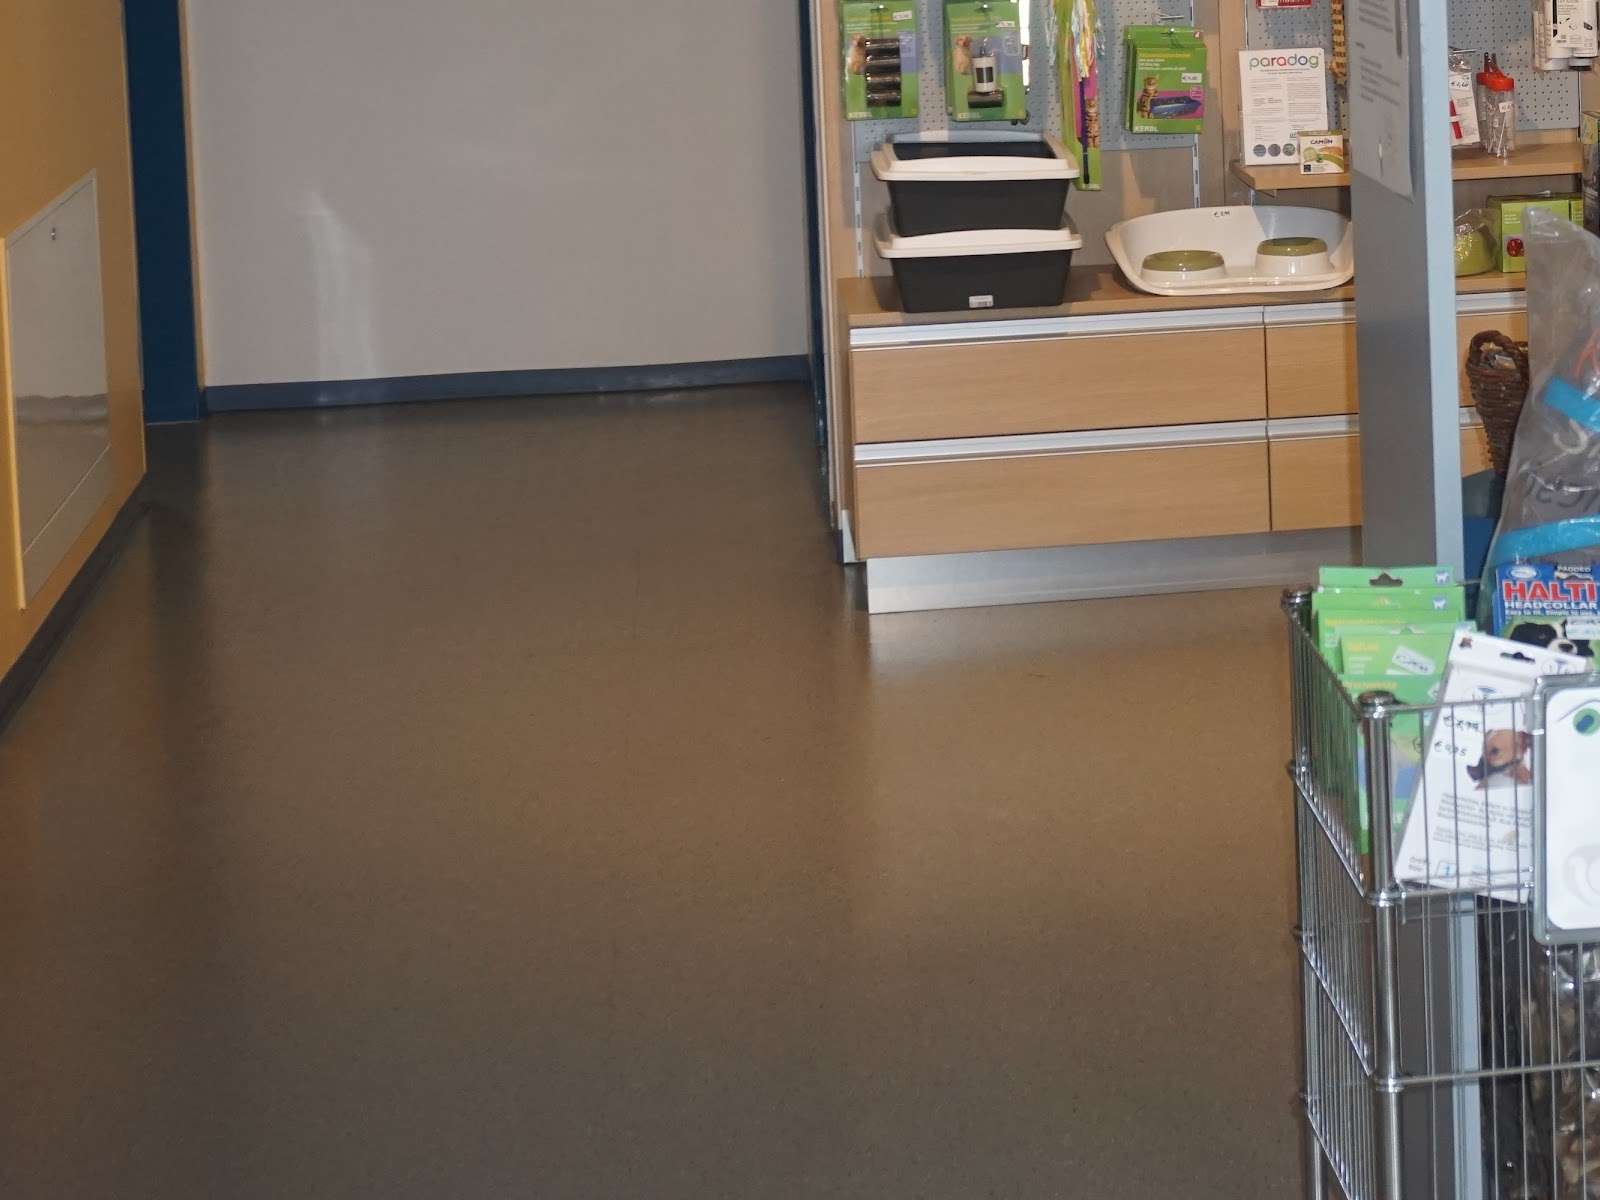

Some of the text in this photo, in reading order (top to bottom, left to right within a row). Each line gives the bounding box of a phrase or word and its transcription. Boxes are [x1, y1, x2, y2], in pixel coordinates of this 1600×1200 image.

[1249, 54, 1320, 71] paradog
[1502, 580, 1598, 603] HALTI
[1505, 602, 1598, 610] HEADCOLLAR
